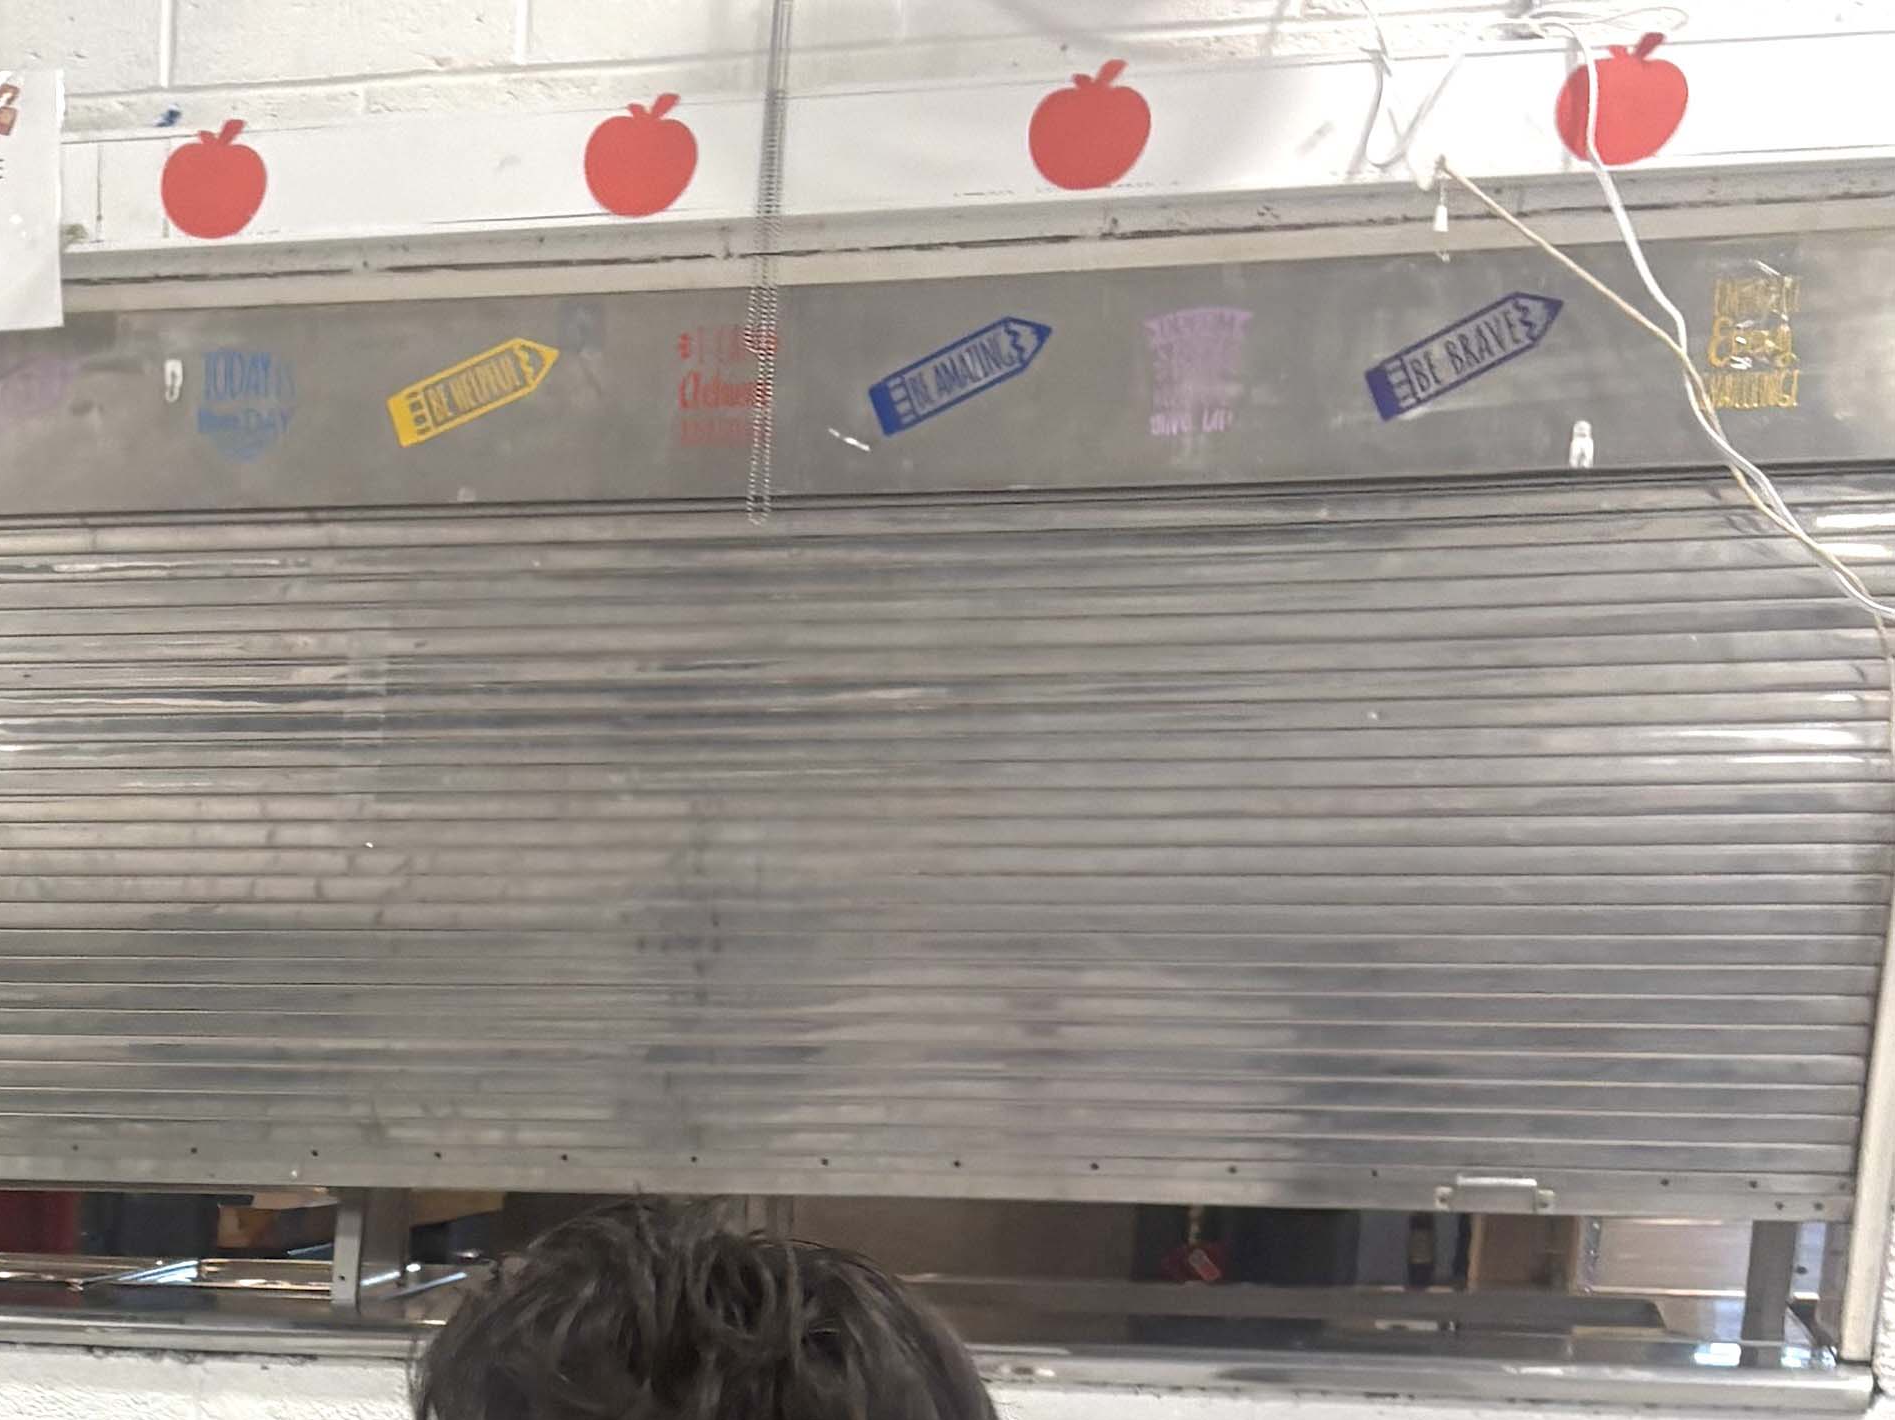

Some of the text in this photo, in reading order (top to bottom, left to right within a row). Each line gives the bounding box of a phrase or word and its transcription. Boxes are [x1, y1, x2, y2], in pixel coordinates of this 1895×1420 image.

[933, 333, 1016, 398] AMAZING
[1409, 311, 1522, 393] BE BRAVE
